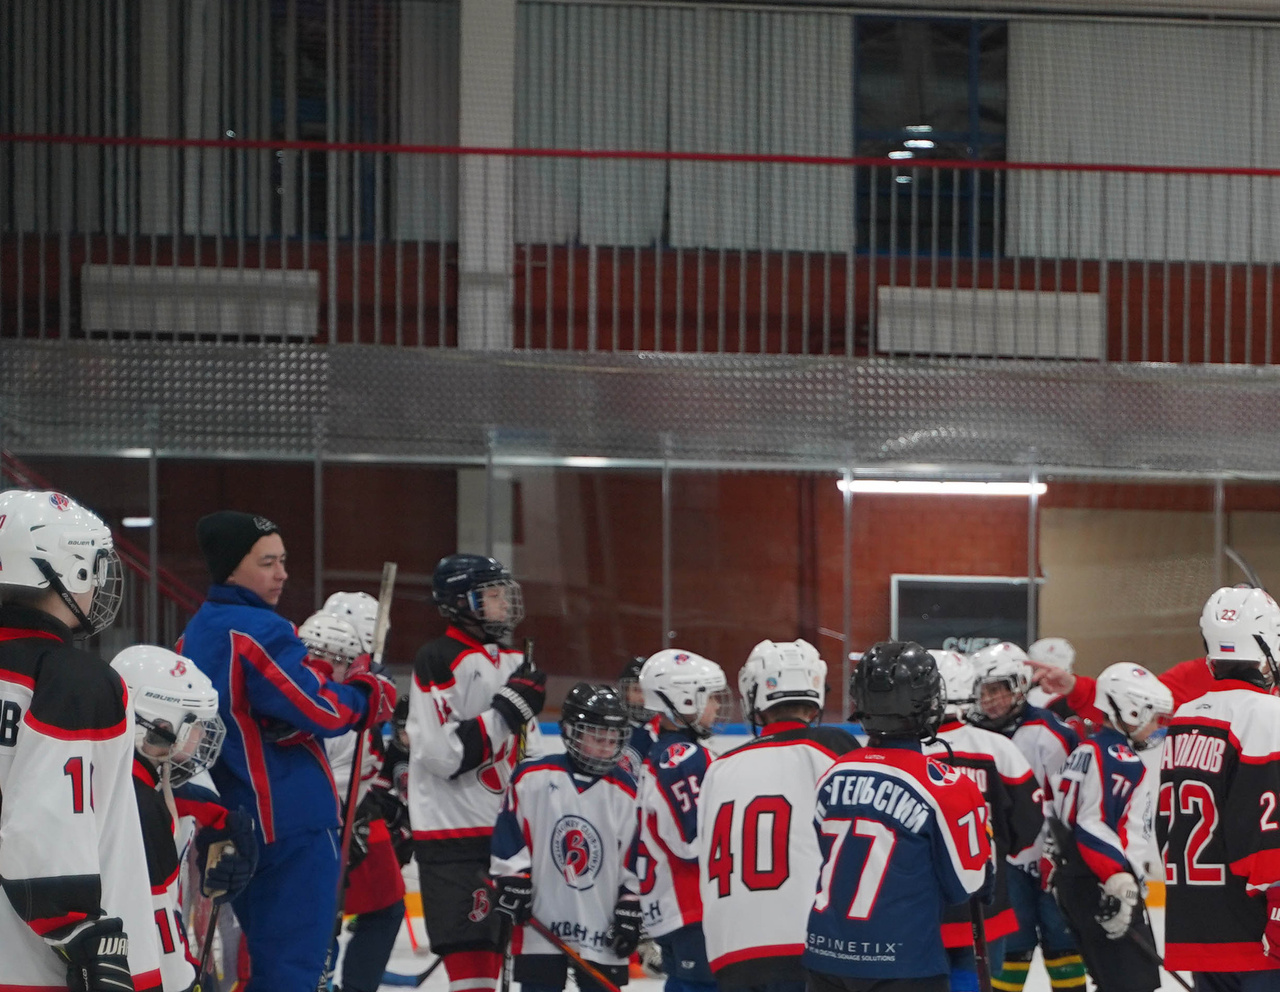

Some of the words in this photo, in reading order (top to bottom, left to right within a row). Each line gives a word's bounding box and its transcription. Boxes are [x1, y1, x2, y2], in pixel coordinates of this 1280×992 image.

[1220, 609, 1236, 621] 22
[145, 691, 181, 704] BAUER
[64, 756, 95, 814] 1
[1111, 773, 1132, 798] 71
[708, 794, 793, 899] 40
[813, 817, 898, 921] 77
[97, 937, 129, 956] WA
[809, 933, 896, 954] SPINETIX
